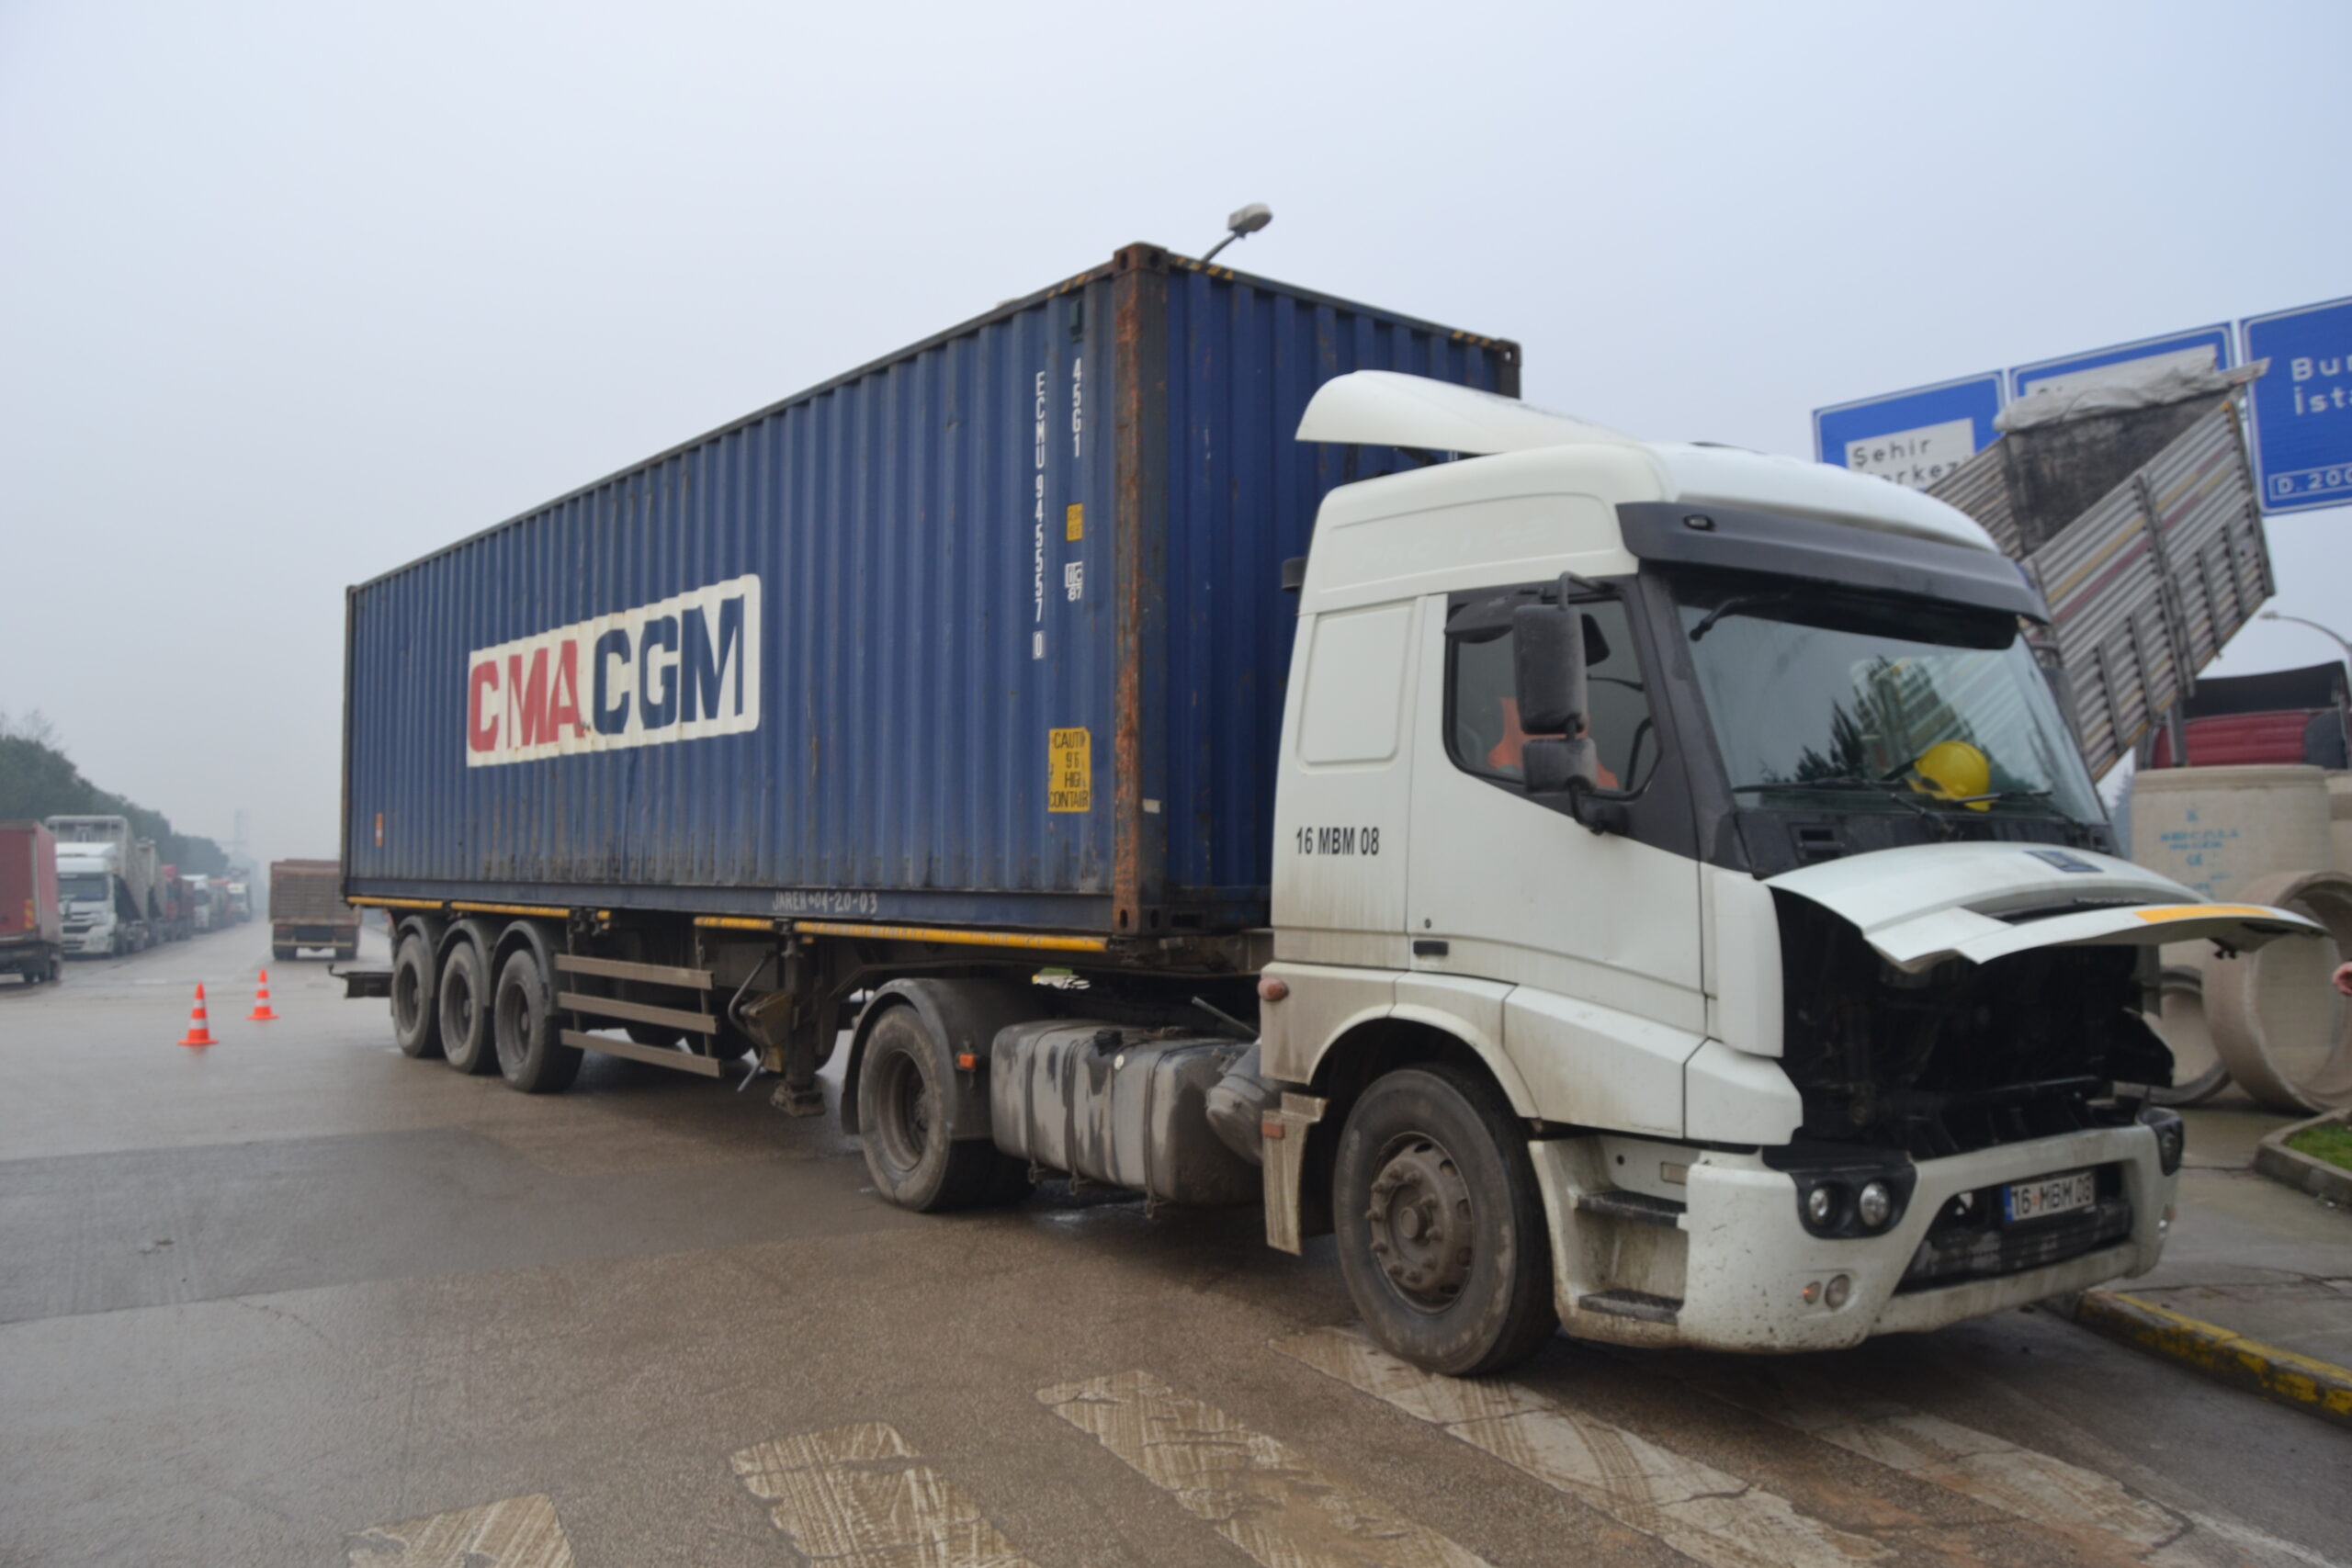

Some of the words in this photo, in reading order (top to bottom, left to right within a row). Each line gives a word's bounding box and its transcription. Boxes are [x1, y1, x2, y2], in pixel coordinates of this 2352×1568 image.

[1035, 370, 1046, 469] ECMU
[1072, 356, 1082, 458] 45G1
[2293, 386, 2352, 416] İst
[1035, 474, 1045, 623] 945557
[469, 639, 586, 753] CMA
[592, 592, 745, 736] CGM
[1296, 827, 1314, 855] 16
[1317, 827, 1355, 855] MBM
[1360, 827, 1380, 856] 08
[2012, 1189, 2031, 1217] 16
